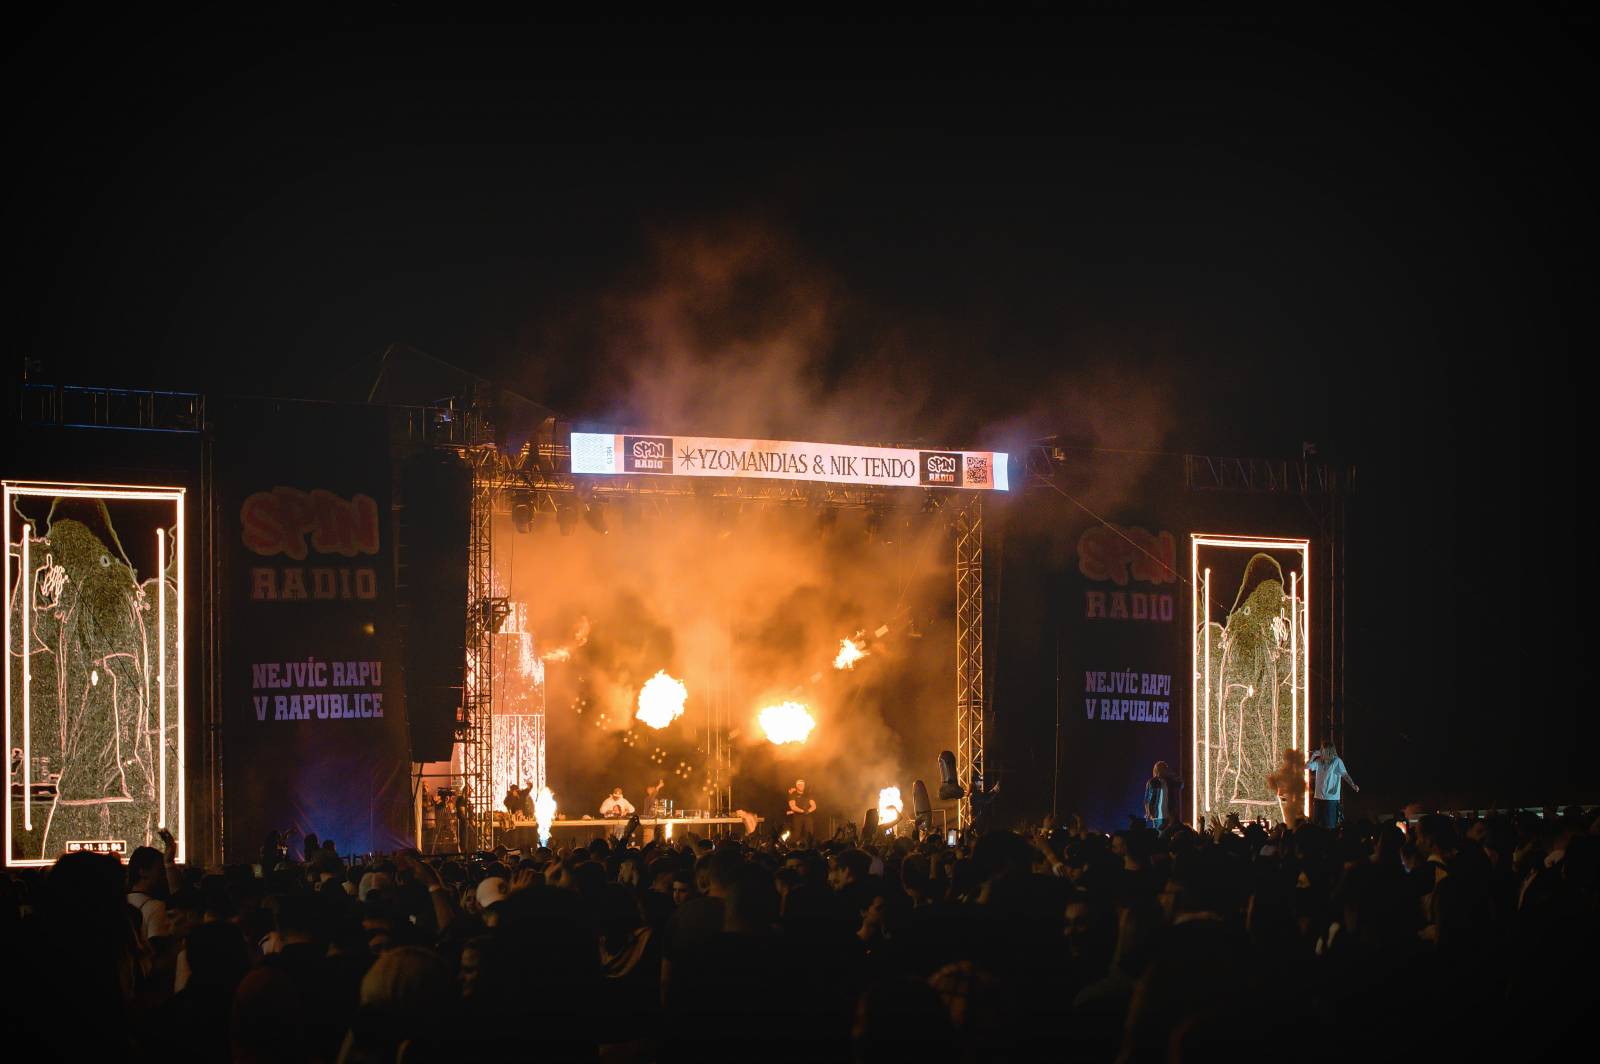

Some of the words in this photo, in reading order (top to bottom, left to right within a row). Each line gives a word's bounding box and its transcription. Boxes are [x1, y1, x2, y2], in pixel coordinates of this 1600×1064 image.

[633, 441, 664, 459] SPIN
[634, 458, 663, 469] RADIO
[698, 448, 808, 474] YZOMANDIAS
[813, 454, 826, 475] &
[830, 455, 859, 477] NIK
[861, 457, 916, 479] TENDO
[928, 456, 956, 473] SPIN
[929, 473, 954, 482] RADIO
[240, 486, 380, 560] SPIN
[1077, 524, 1176, 586] SPIN
[252, 567, 378, 599] RADIO
[1086, 591, 1174, 621] RADIO
[252, 656, 328, 689] NEJVÍC
[332, 661, 383, 687] RAPU
[1085, 667, 1139, 694] NEJVÍC
[1141, 673, 1171, 697] RAPU
[253, 696, 269, 721] V
[274, 693, 385, 721] RAPUBLICE
[1085, 698, 1097, 720] V
[1100, 699, 1170, 724] RAPUBLICE
